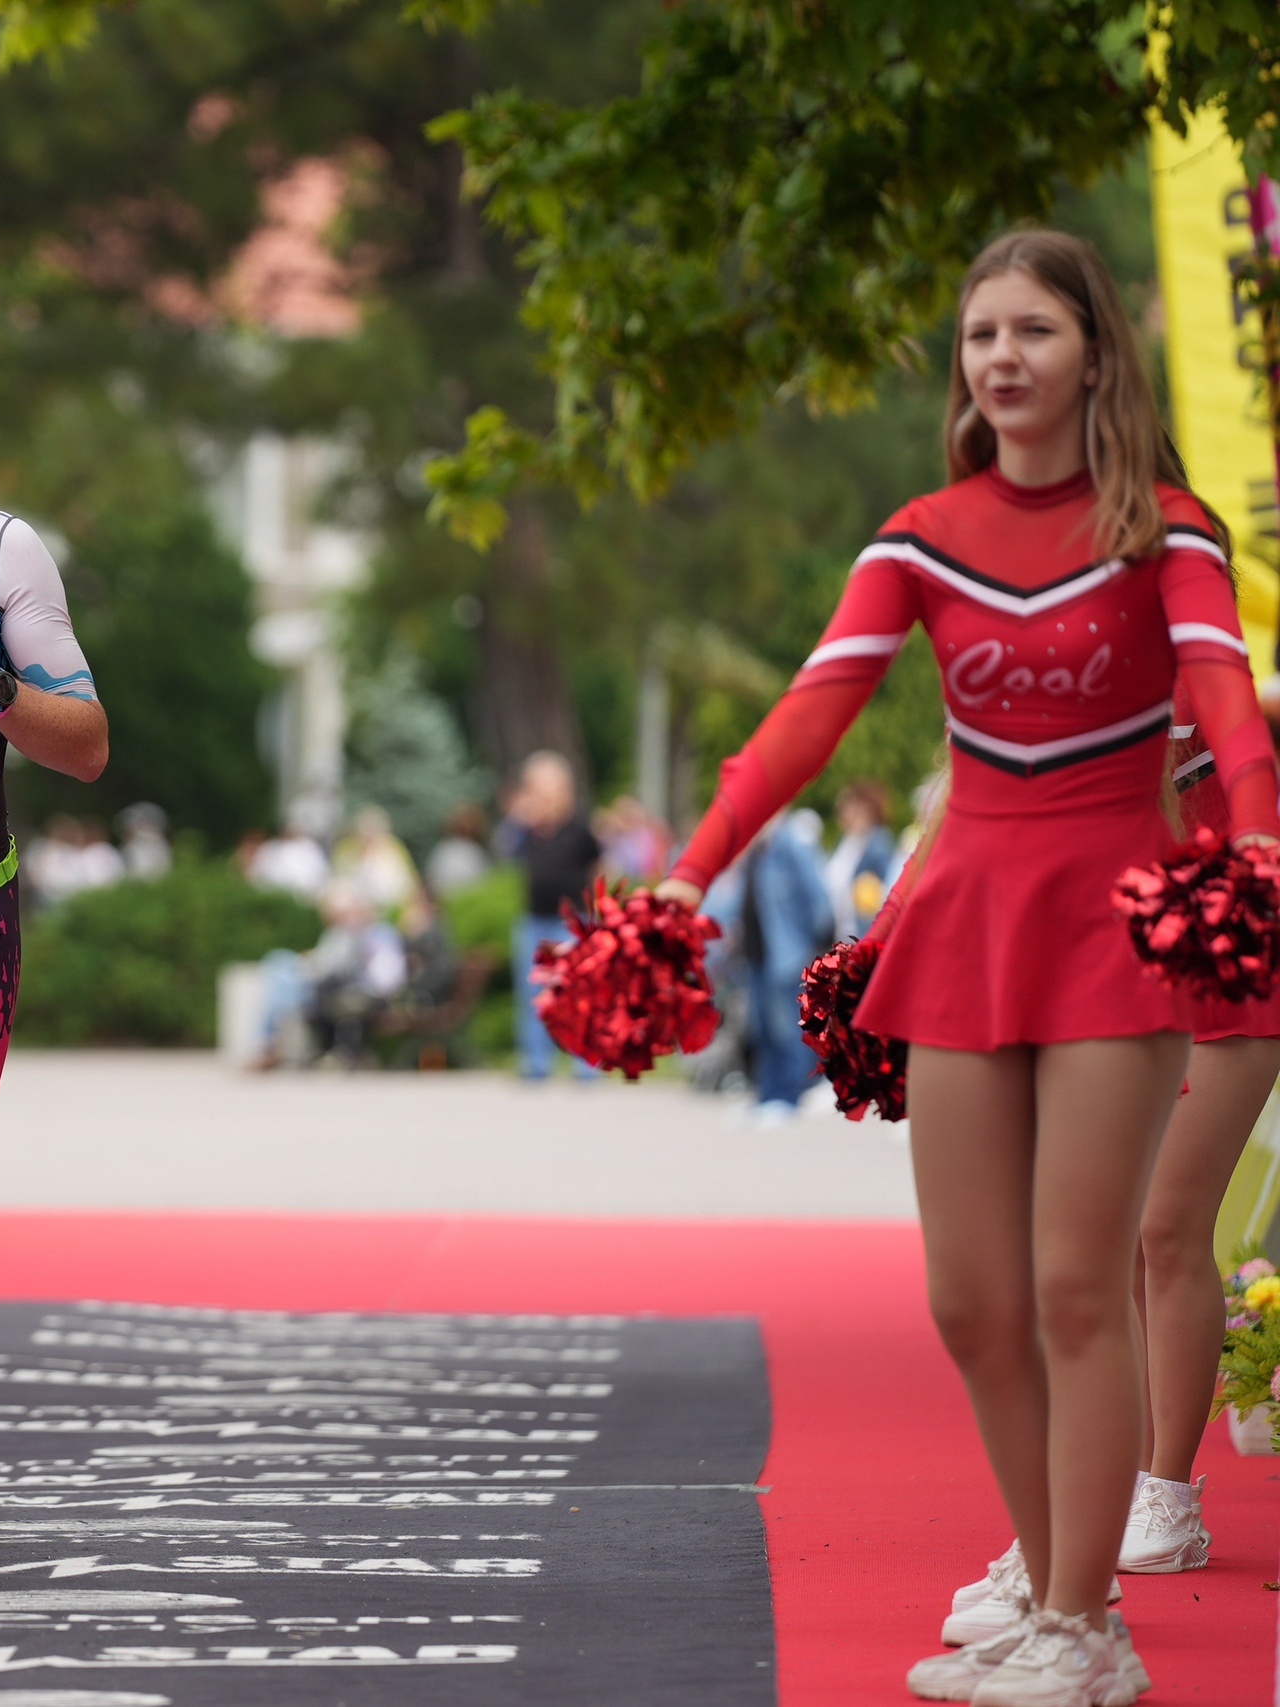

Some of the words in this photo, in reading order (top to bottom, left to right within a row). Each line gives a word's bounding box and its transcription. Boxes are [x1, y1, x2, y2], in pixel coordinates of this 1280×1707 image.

[946, 638, 1112, 706] Cool
[226, 1491, 556, 1504] STAR
[172, 1555, 542, 1573] STAR
[95, 1645, 518, 1662] STAR
